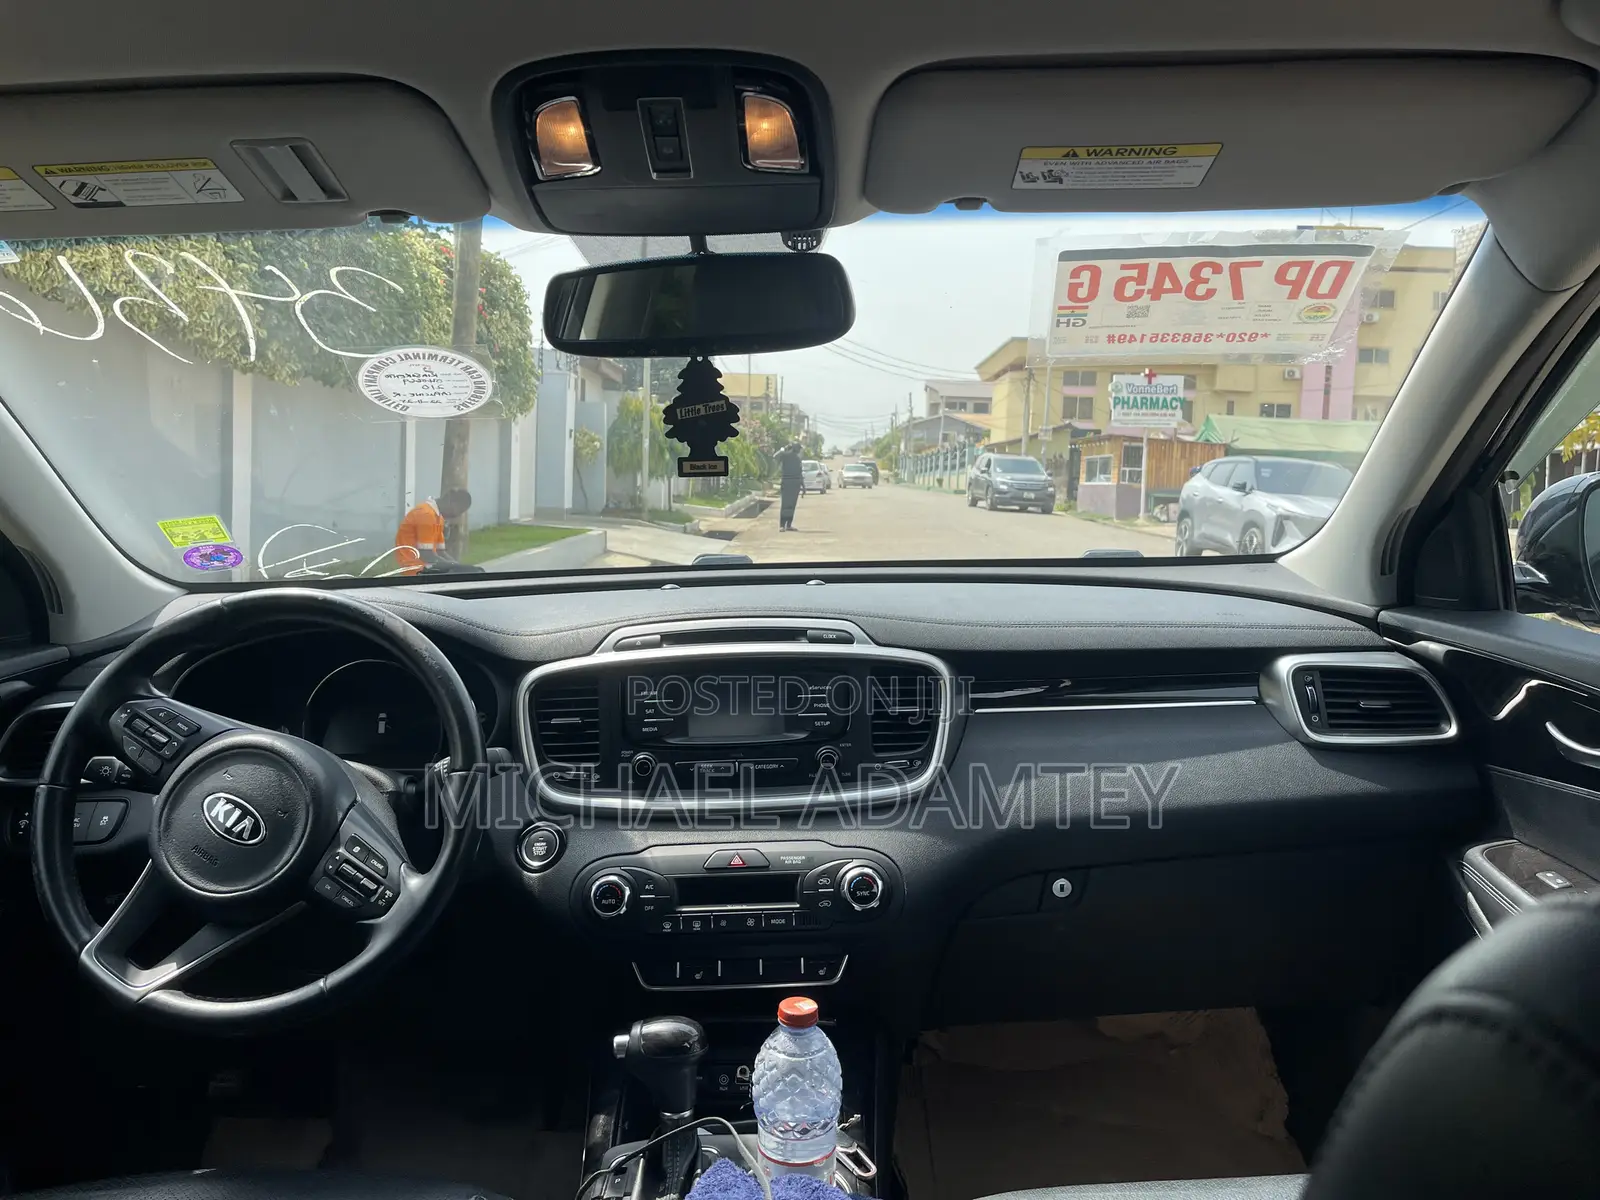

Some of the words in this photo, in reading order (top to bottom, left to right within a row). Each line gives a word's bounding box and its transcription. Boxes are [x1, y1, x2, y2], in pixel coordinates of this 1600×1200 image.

[1085, 146, 1178, 157] WARNING
[1126, 383, 1177, 394] VonneBert
[679, 405, 701, 418] Little
[702, 402, 725, 414] Trees
[1113, 395, 1186, 411] PHARMACY
[209, 797, 255, 840] KIA
[190, 844, 220, 867] AIRBAG
